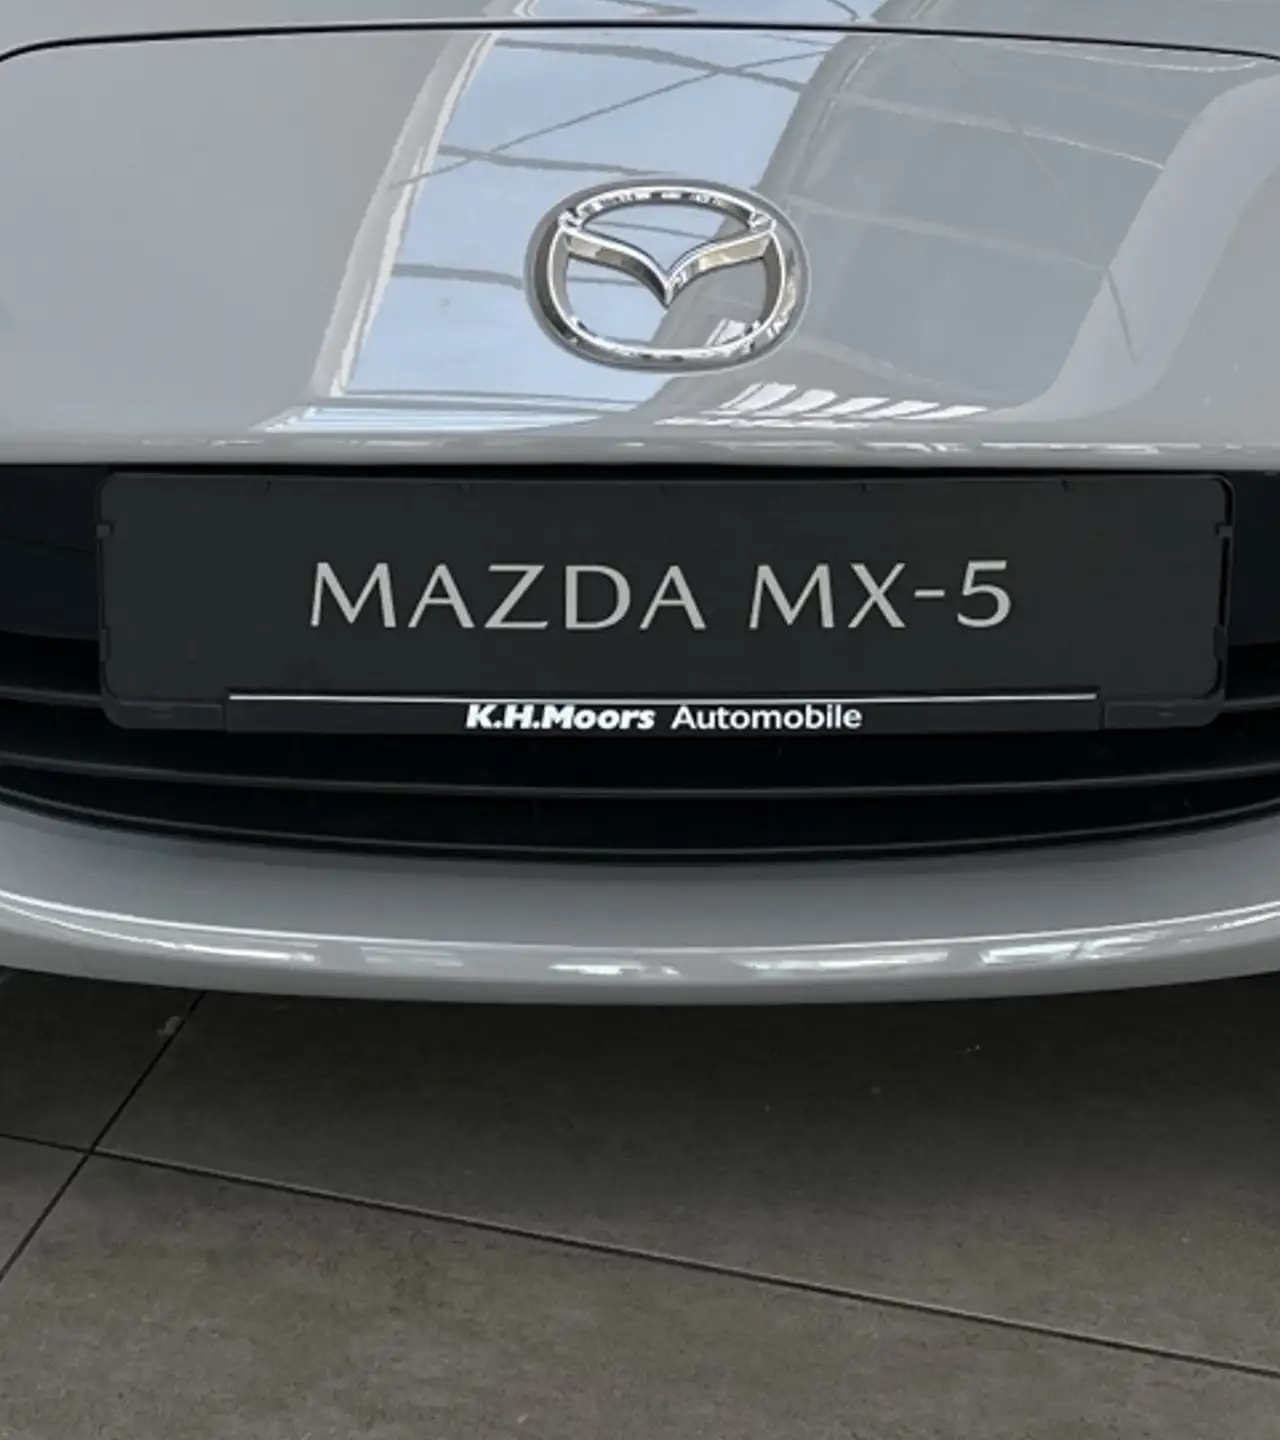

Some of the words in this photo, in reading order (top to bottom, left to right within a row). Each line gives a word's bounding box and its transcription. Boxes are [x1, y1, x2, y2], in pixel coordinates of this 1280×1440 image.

[310, 561, 707, 631] MAZDA
[749, 559, 1012, 631] MX-5
[465, 703, 656, 732] K.H.Moors
[670, 703, 864, 732] Automobile
